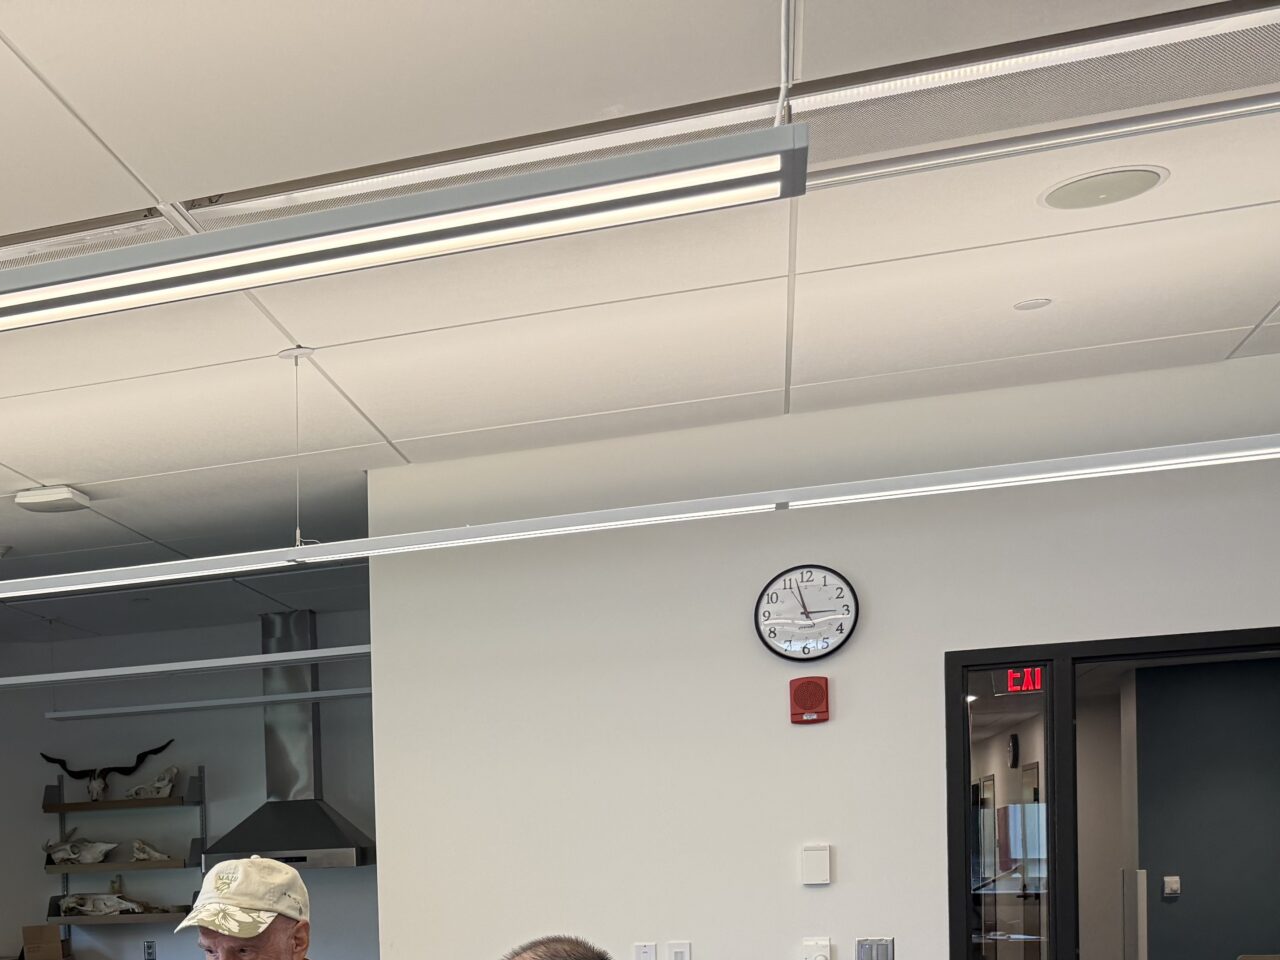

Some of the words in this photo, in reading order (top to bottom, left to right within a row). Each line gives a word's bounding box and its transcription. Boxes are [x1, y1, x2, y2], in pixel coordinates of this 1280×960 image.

[800, 570, 815, 583] 12
[822, 575, 828, 587] 1
[783, 578, 793, 590] 11
[766, 592, 779, 604] 10
[835, 587, 845, 600] 2
[762, 610, 771, 621] 9
[842, 604, 851, 616] 3
[768, 627, 777, 639] 8
[835, 622, 845, 634] 4
[783, 639, 793, 652] 7
[802, 643, 811, 655] 6
[821, 637, 830, 650] 5
